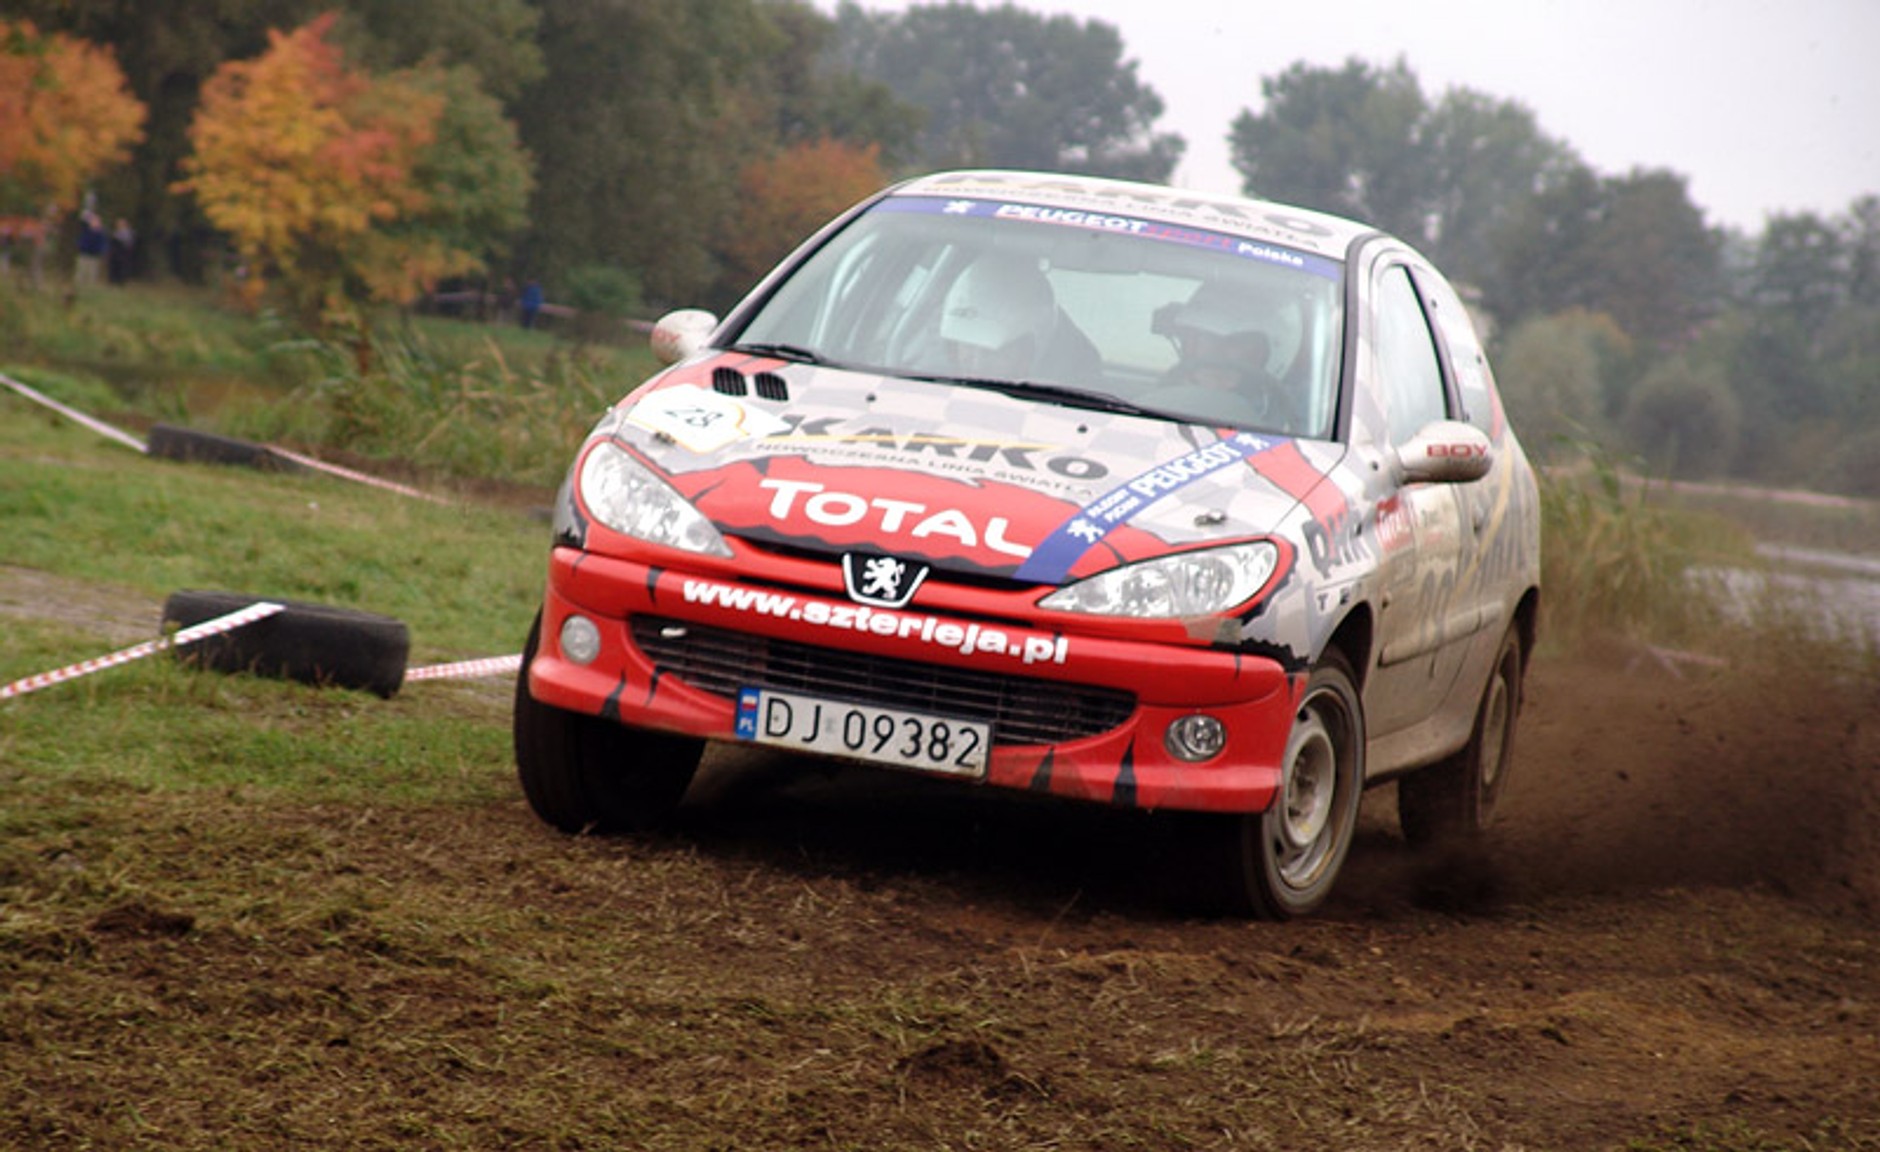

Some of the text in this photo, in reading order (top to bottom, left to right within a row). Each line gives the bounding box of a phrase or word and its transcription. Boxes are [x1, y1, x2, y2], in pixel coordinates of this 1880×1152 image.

[995, 204, 1148, 233] PEUGEOT
[1237, 242, 1304, 266] Polska
[664, 406, 724, 428] 28
[767, 414, 1109, 481] KARKO
[928, 459, 986, 475] LINIA
[1128, 441, 1242, 498] PEUGEOT
[758, 477, 1034, 558] TOTAL
[765, 696, 981, 769] DJ 09382
